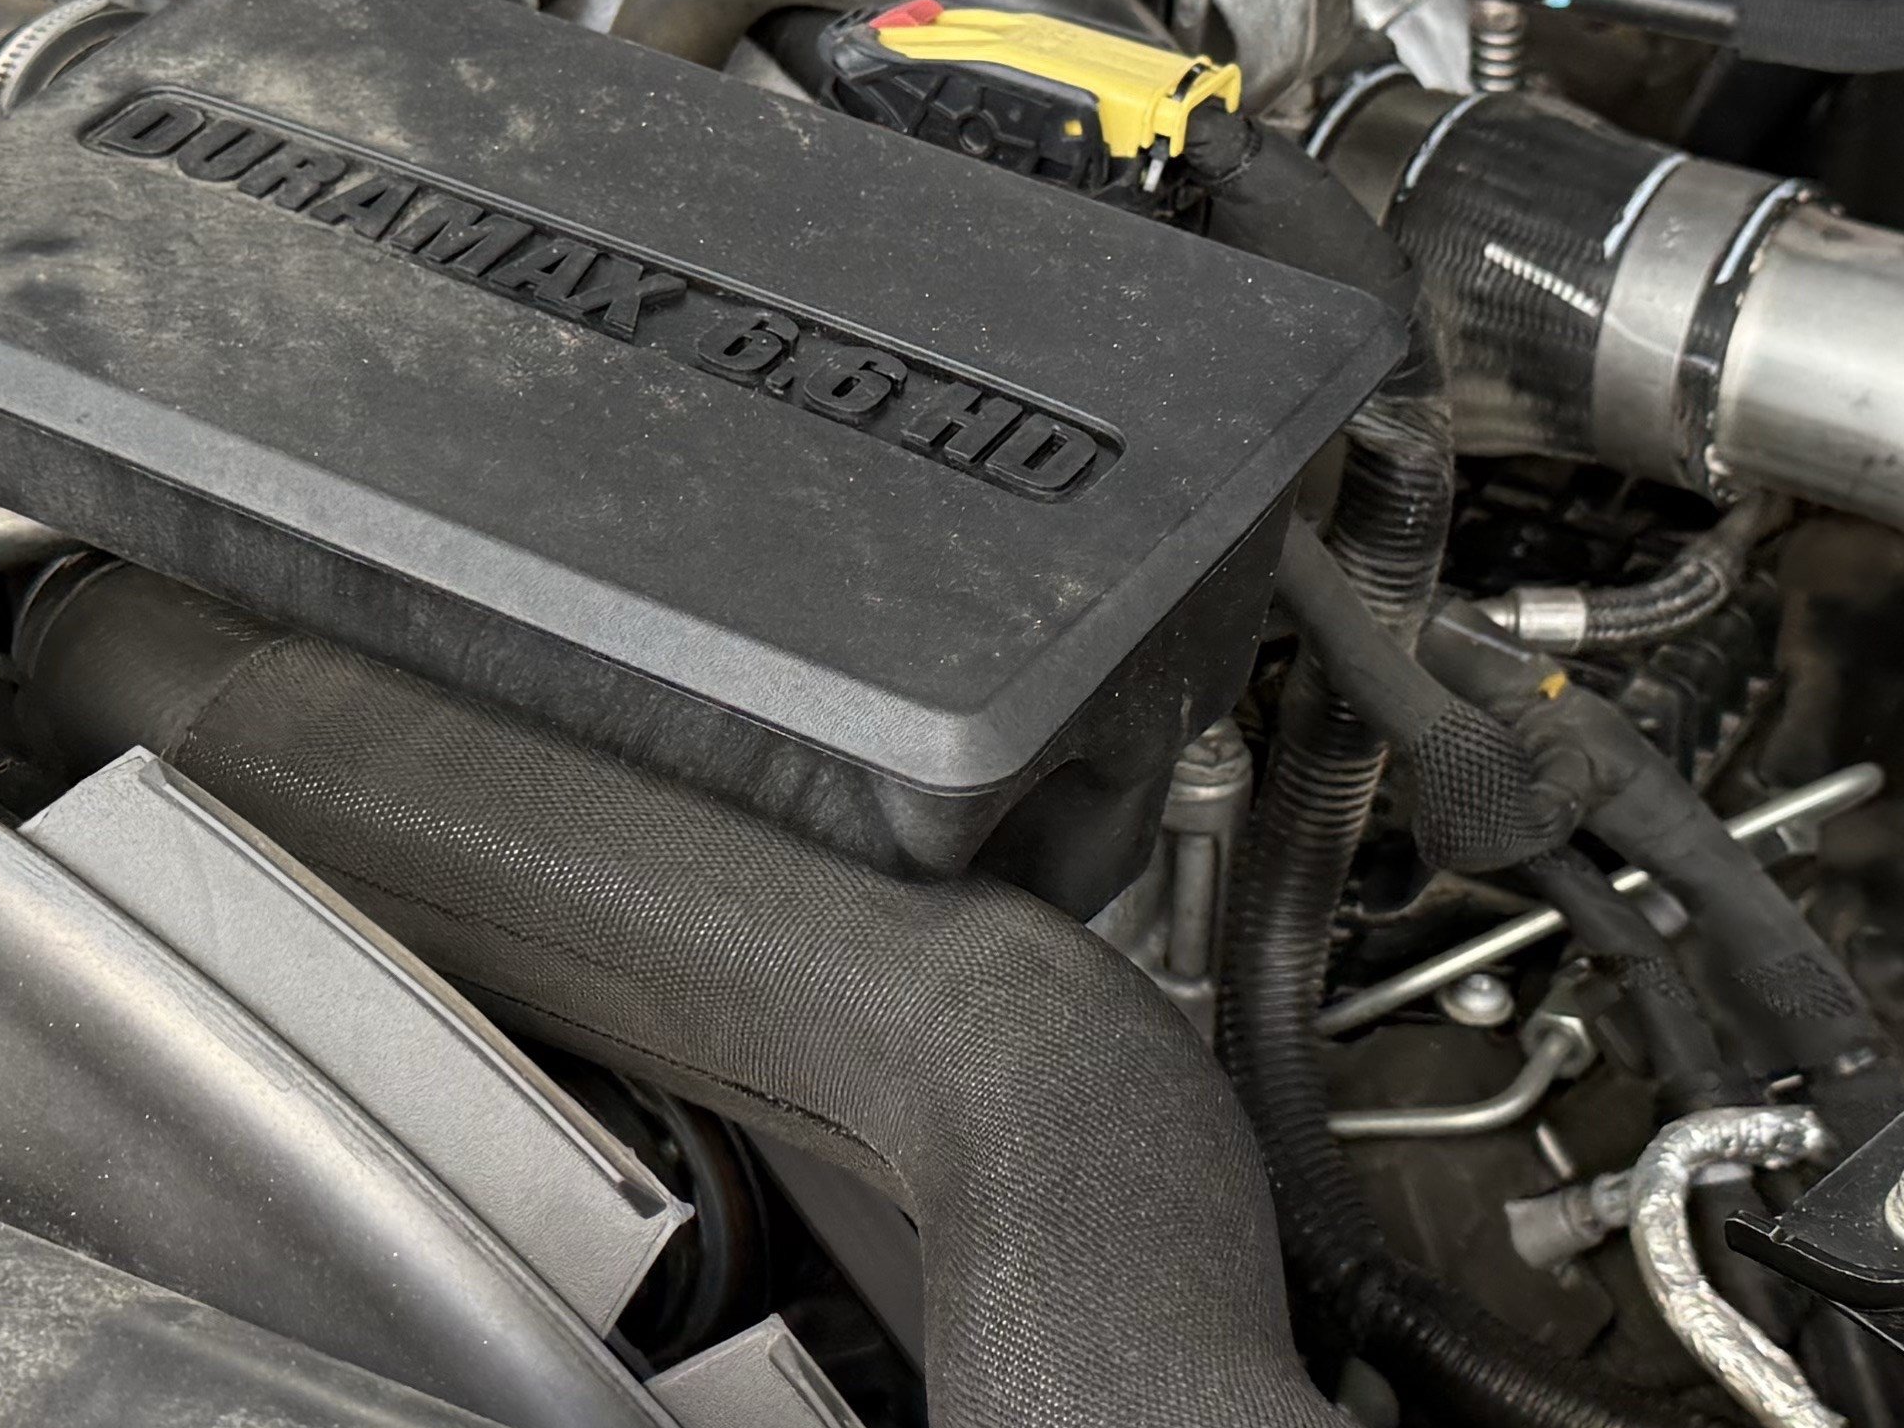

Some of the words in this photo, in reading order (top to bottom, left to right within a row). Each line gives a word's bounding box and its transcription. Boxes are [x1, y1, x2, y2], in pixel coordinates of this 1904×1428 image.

[99, 96, 688, 338] DURAMAX
[702, 309, 906, 427] 6.6
[902, 382, 1101, 495] HD
